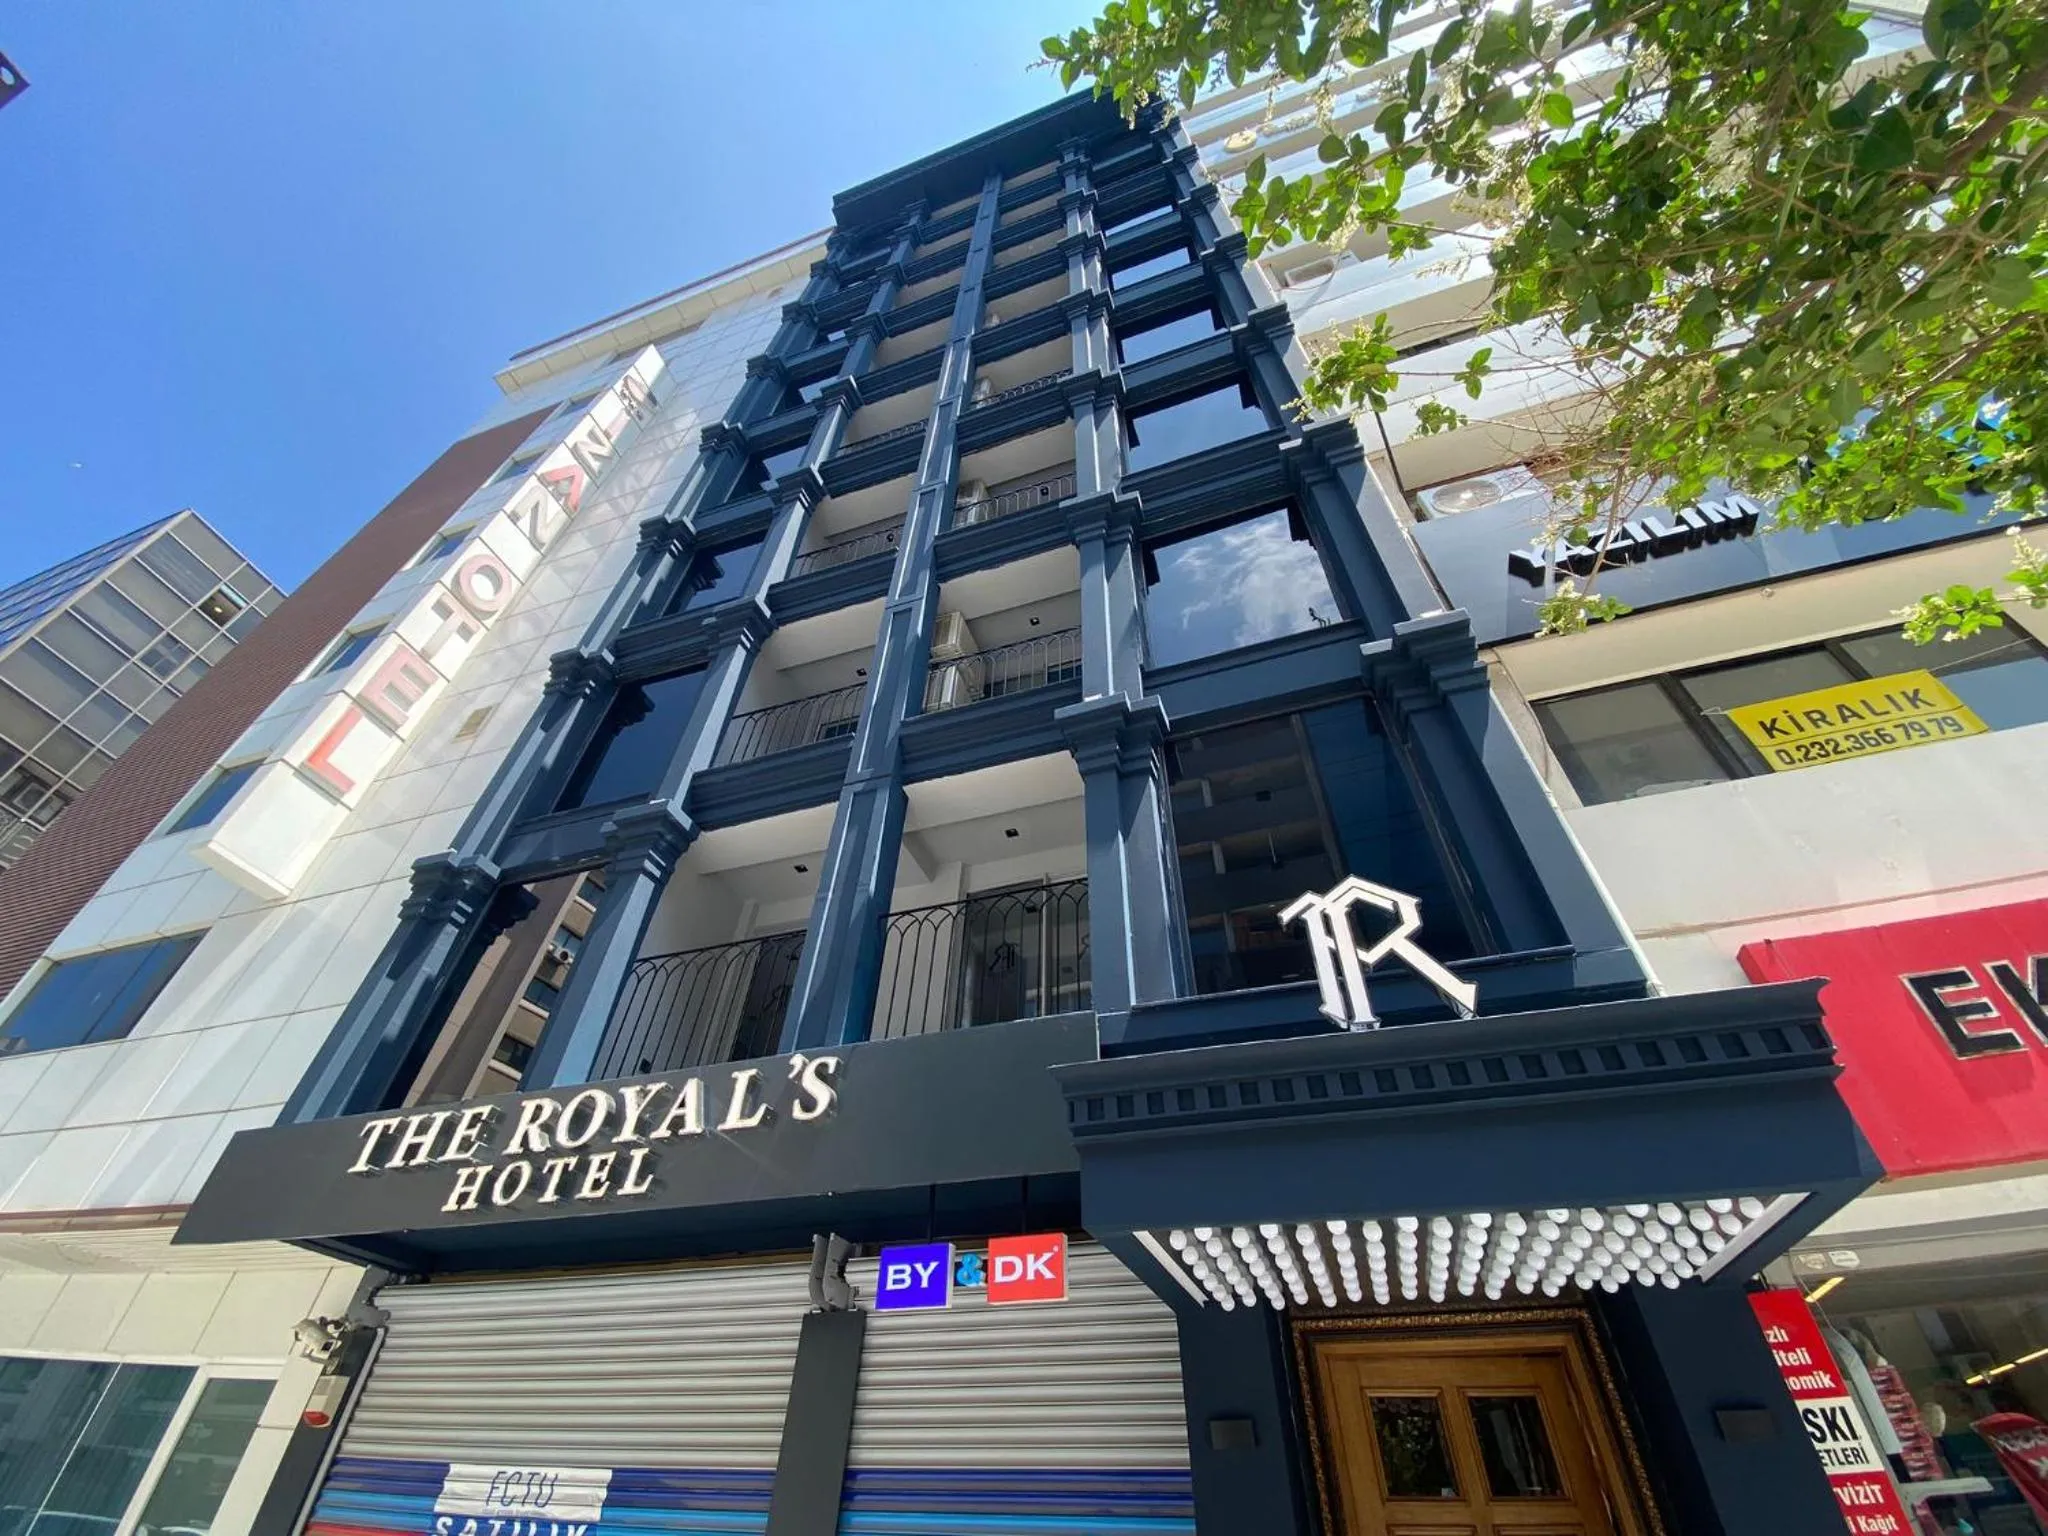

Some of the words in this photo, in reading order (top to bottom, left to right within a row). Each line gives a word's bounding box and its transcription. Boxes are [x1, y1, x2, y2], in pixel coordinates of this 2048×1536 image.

[1508, 494, 1760, 570] YAZILIM
[1758, 688, 1935, 740] KİRALIK
[347, 1103, 500, 1174] THE
[502, 1053, 844, 1155] ROYAL'S
[441, 1148, 657, 1212] HOTEL
[885, 1261, 939, 1291] BY
[956, 1252, 985, 1287] &
[993, 1248, 1058, 1283] DK
[1801, 1405, 1859, 1444] SKI
[1833, 1480, 1886, 1506] VİZİT
[1857, 1513, 1899, 1535] Kağıt
